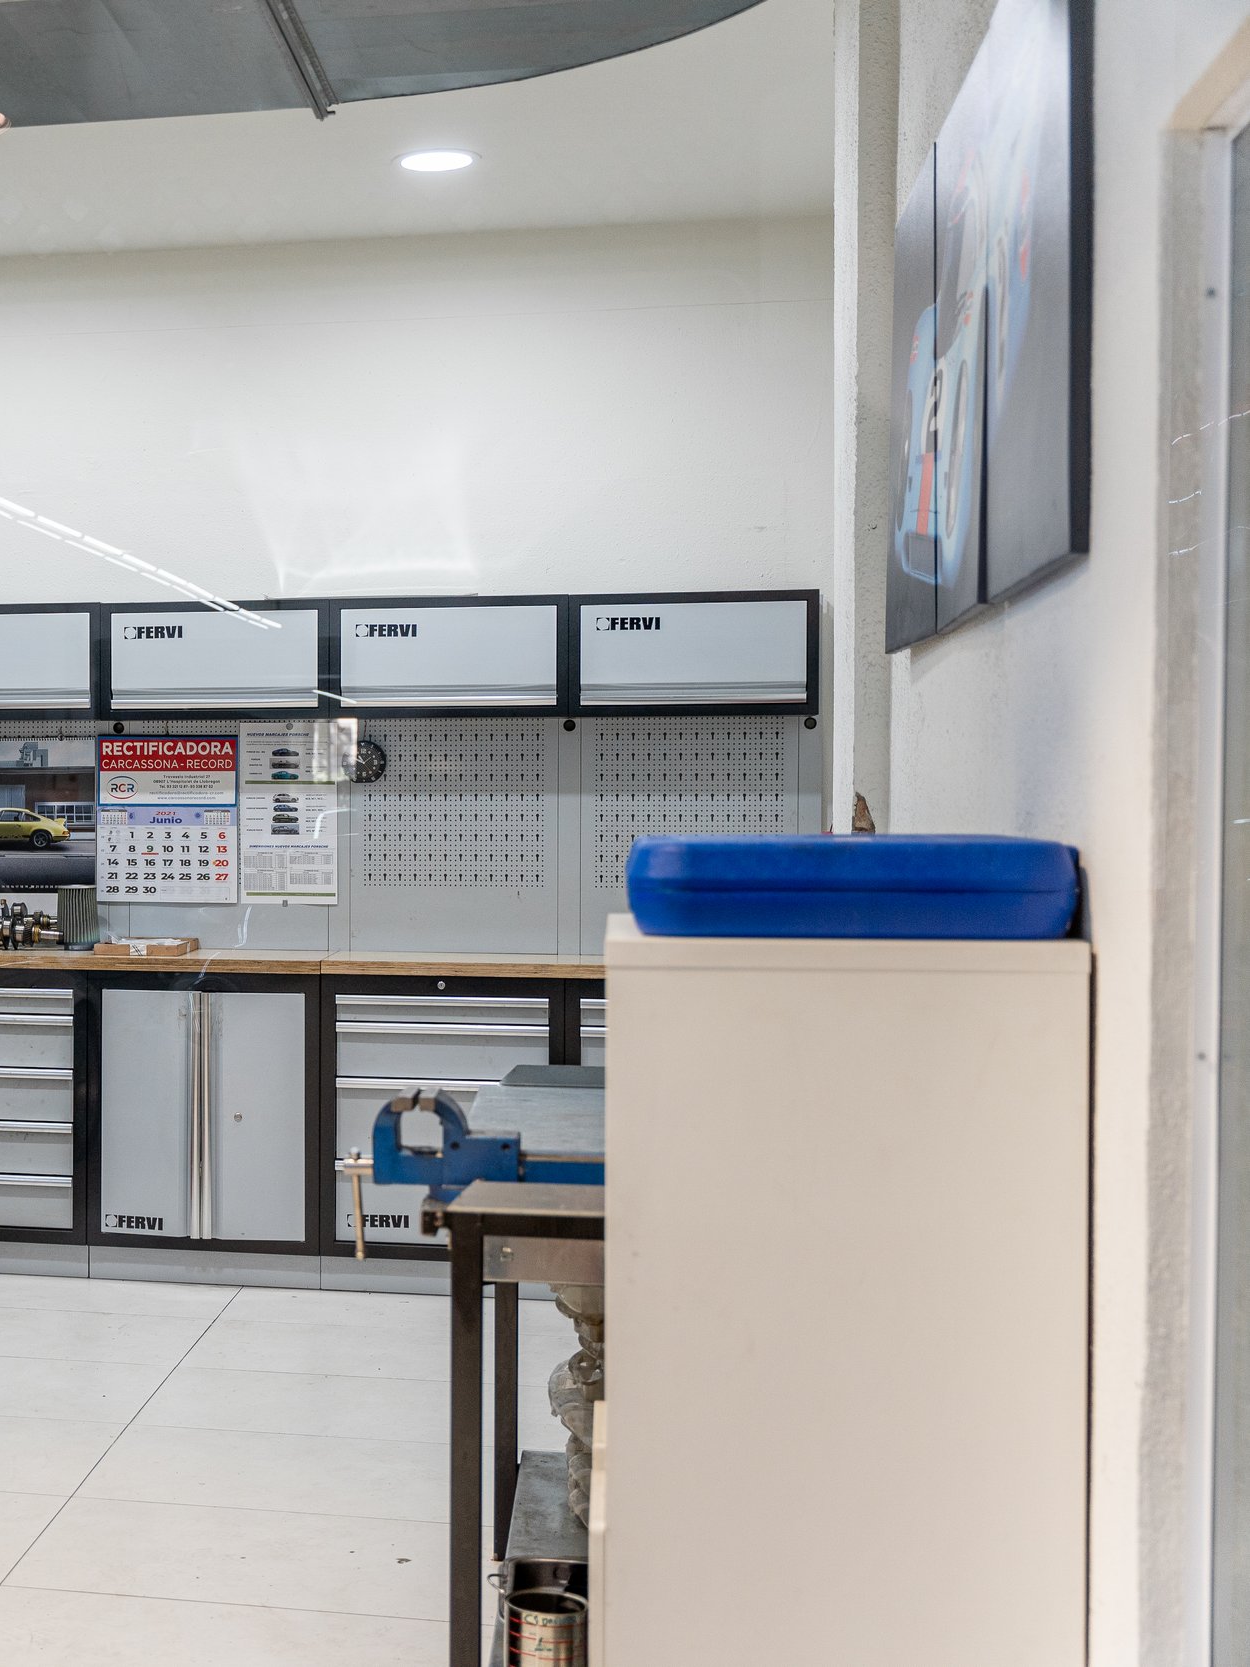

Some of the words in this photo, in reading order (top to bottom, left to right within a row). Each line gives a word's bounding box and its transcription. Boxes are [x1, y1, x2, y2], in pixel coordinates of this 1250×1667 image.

[611, 617, 661, 631] FERVI
[137, 625, 183, 640] FERVI
[369, 624, 418, 638] FERVI
[102, 742, 233, 756] RECTIFICADORA
[102, 759, 179, 769] CARCASSONA
[186, 759, 233, 769] RECORD
[111, 783, 135, 793] RCR
[150, 816, 182, 824] Junio
[129, 831, 134, 839] 1
[146, 831, 154, 839] 2
[128, 845, 136, 853] 8
[146, 845, 154, 853] 9
[162, 845, 174, 853] 10
[180, 845, 190, 853] 11
[162, 859, 174, 867] 17
[179, 859, 191, 867] 18
[197, 859, 209, 867] 19
[215, 859, 229, 867] 20
[107, 872, 118, 880] 21
[125, 872, 138, 880] 22
[161, 873, 175, 881] 24
[179, 873, 192, 881] 25
[196, 873, 210, 881] 26
[215, 873, 229, 881] 27
[125, 886, 138, 894] 29
[142, 886, 157, 894] 30
[118, 1215, 164, 1231] FERVI
[362, 1214, 410, 1229] FERVI
